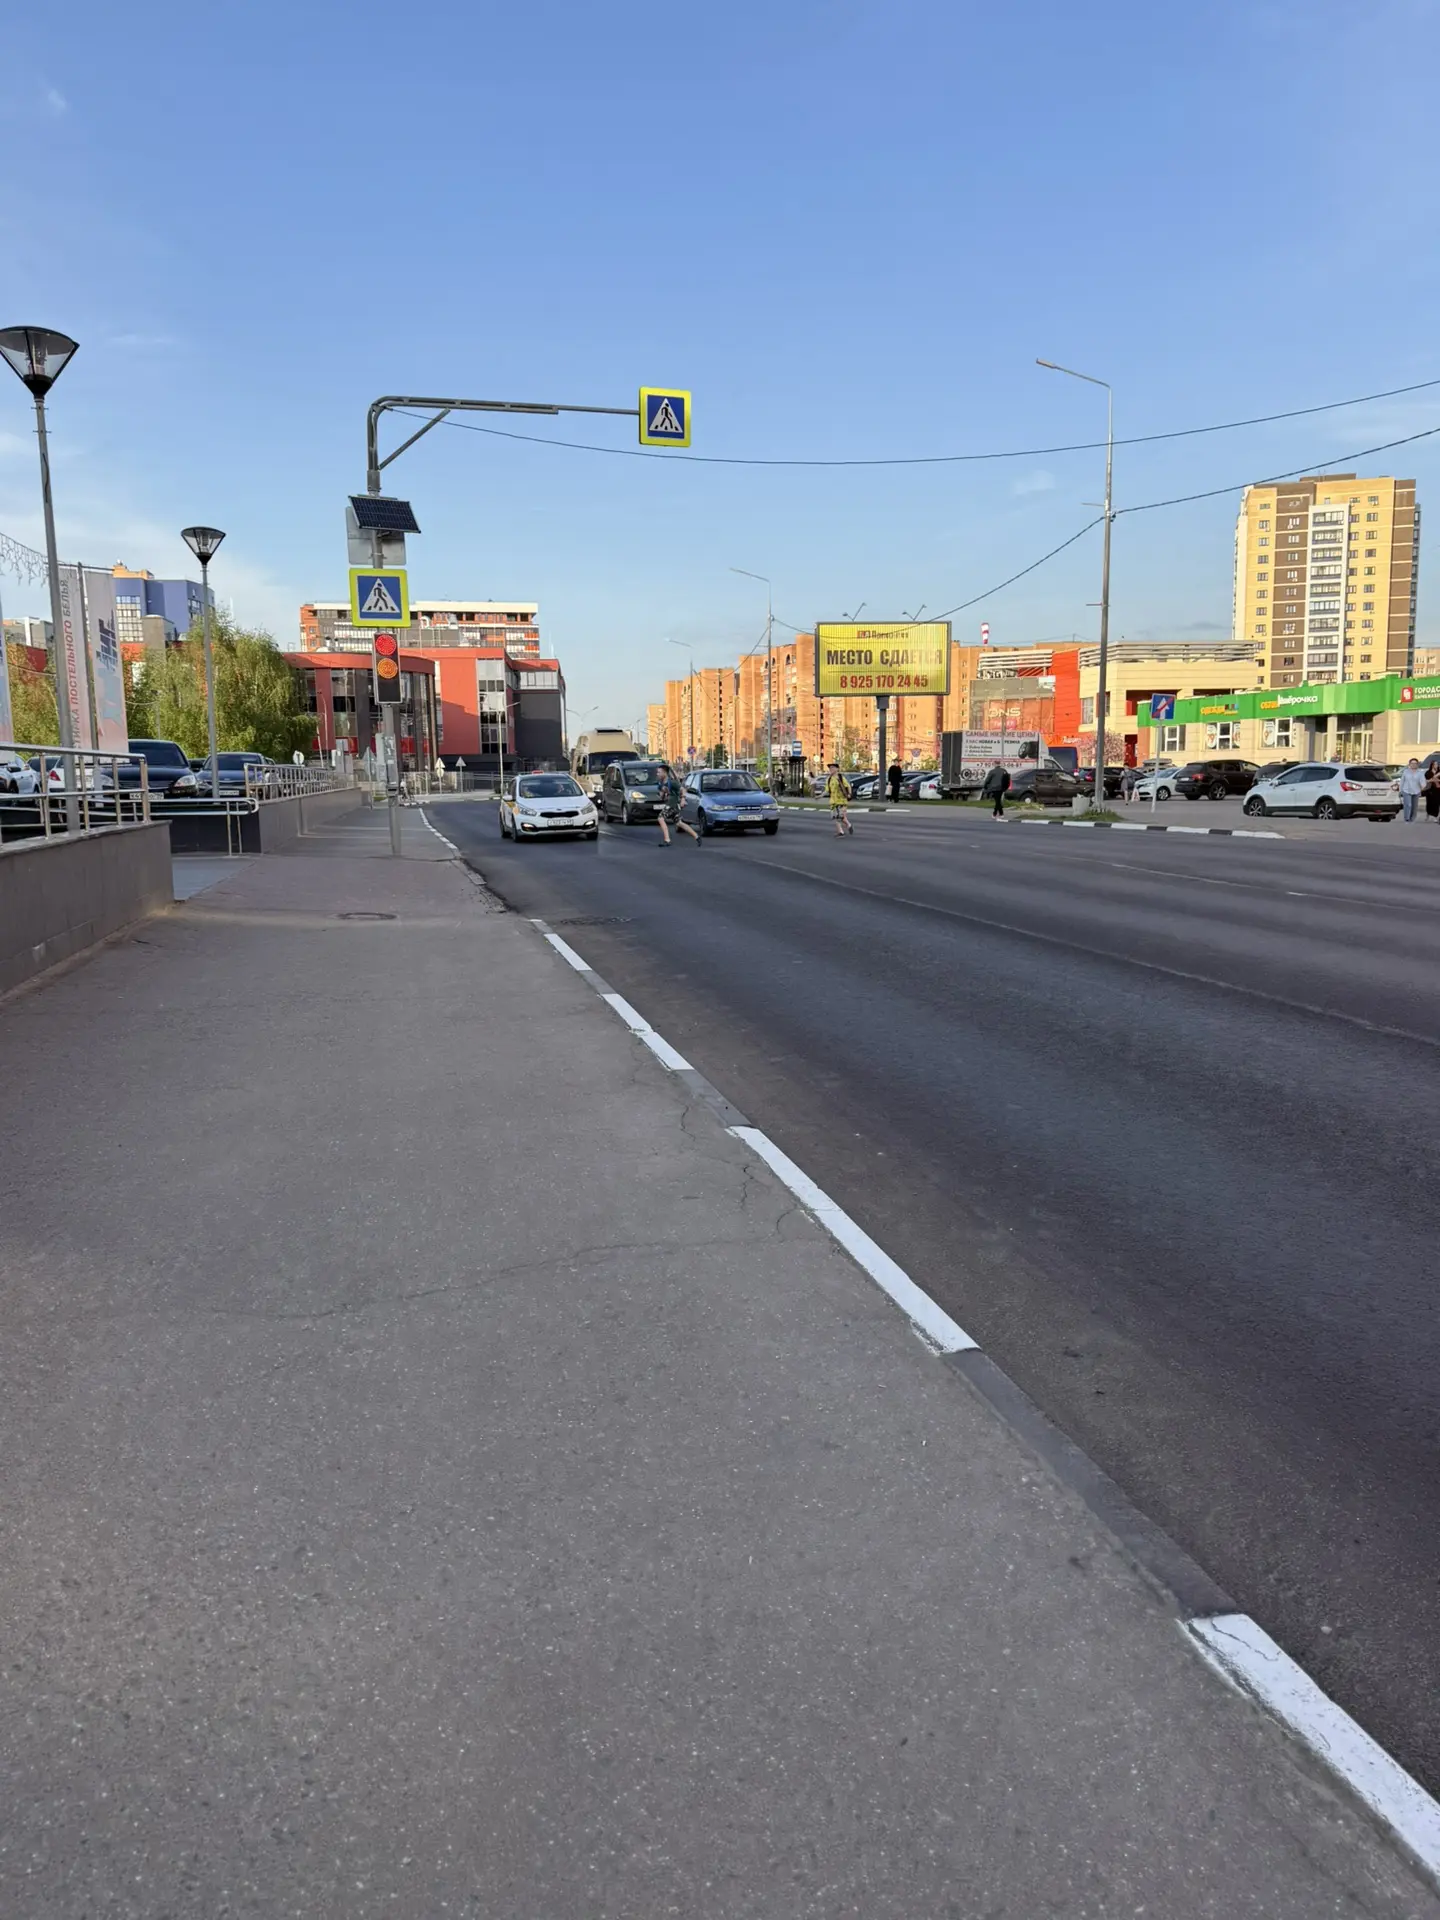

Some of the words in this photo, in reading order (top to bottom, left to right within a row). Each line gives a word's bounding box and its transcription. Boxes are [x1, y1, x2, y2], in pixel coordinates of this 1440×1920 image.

[60, 579, 71, 617] БЕЛЬЯ
[64, 620, 78, 705] ПОСТЕЛЬНОГО
[826, 649, 873, 665] МЕСТО
[840, 675, 848, 689] 8
[850, 675, 873, 688] 925
[875, 674, 895, 688] 170
[897, 674, 911, 687] 24
[914, 674, 928, 687] 45
